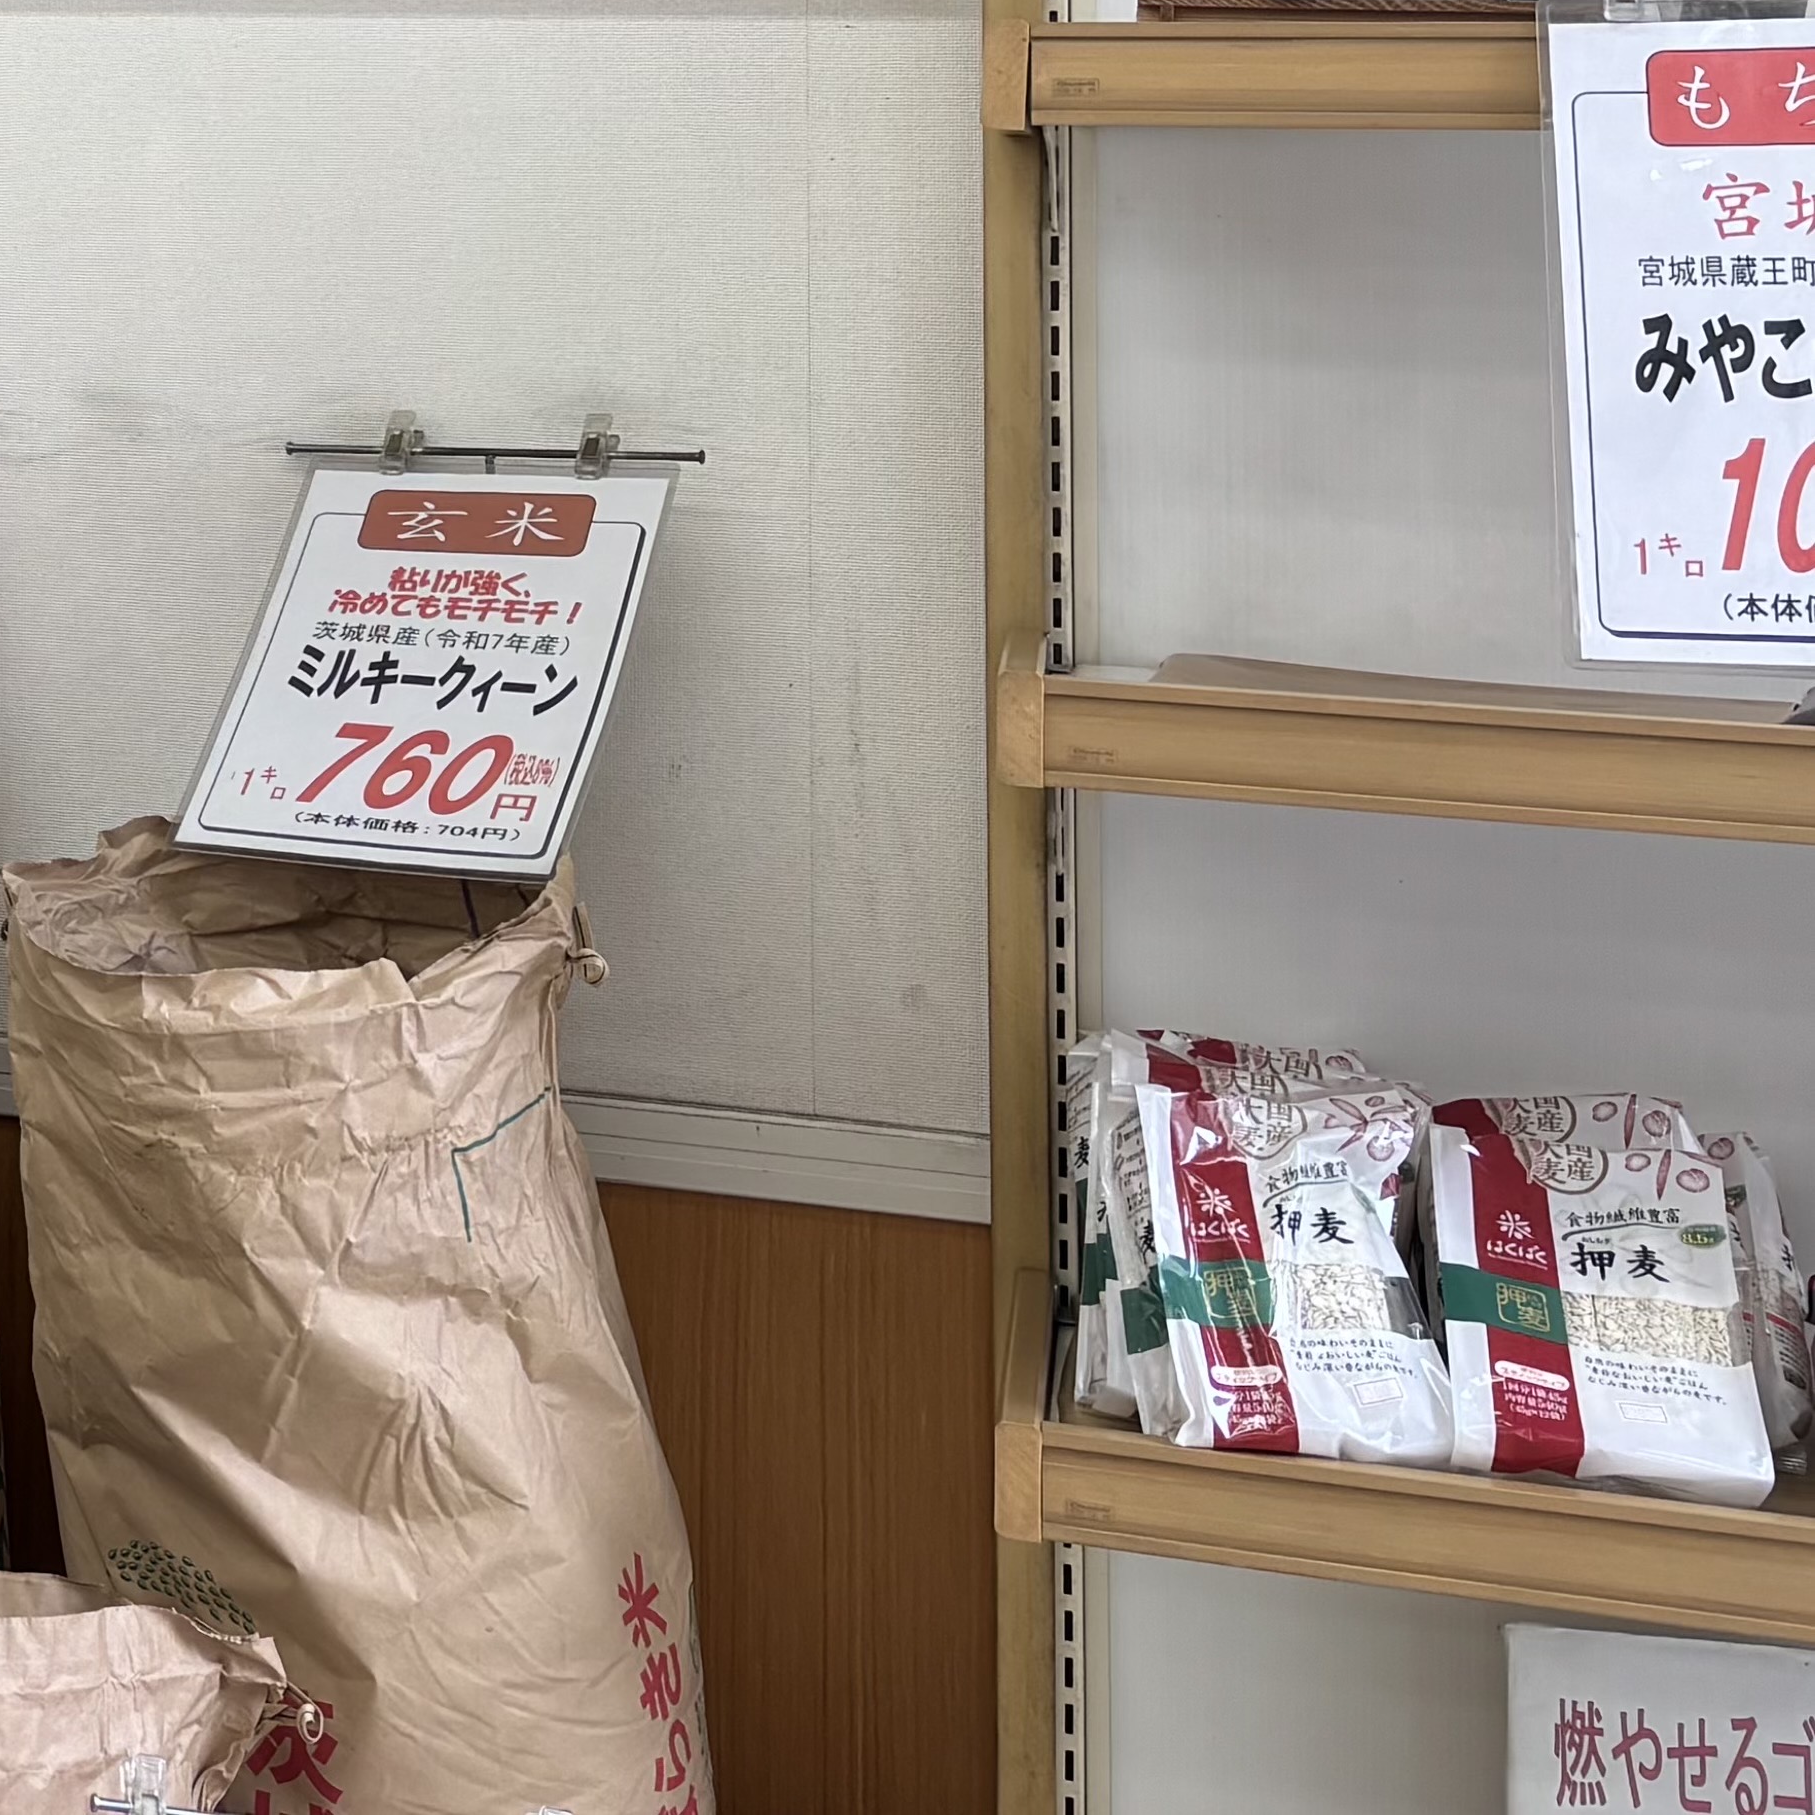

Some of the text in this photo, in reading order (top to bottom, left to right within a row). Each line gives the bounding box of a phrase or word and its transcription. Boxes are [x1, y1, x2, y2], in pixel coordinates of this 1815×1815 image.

[1634, 312, 1813, 404] みやこ
[386, 500, 565, 547] 玄米
[326, 588, 583, 626] 冷めてもモチモチ！
[311, 621, 572, 658] 茨城県産（令和7年産）
[287, 643, 579, 717] ミルキークィーン
[294, 722, 514, 816] 760
[489, 792, 538, 822] 円
[1270, 1204, 1355, 1247] 押麦
[1486, 1239, 1548, 1263] はくばく
[1569, 1242, 1671, 1284] 押麦
[1553, 1697, 1815, 1815] 燃やせるゴ
